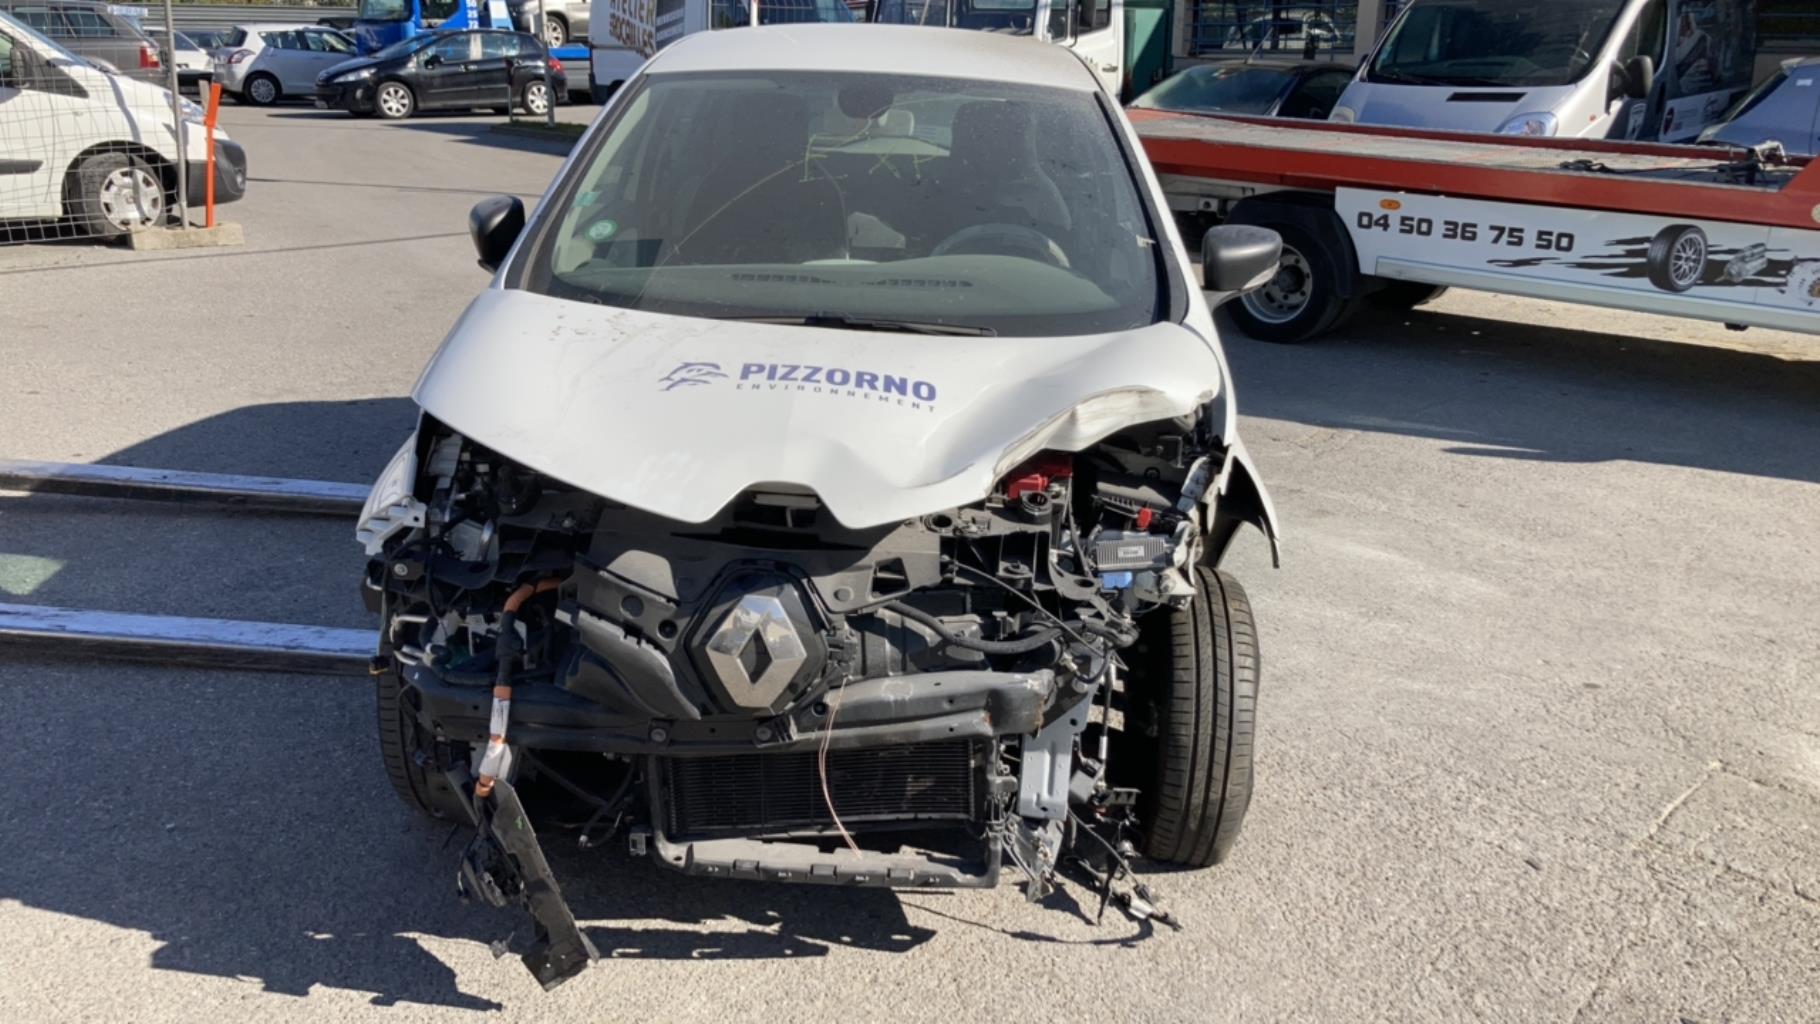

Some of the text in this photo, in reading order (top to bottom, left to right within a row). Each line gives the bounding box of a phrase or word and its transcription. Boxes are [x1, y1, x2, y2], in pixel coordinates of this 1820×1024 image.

[1357, 211, 1575, 252] 04 50 36 75 50
[736, 383, 936, 413] ENVIRONNEMENT
[739, 363, 937, 402] PIZZORNO
